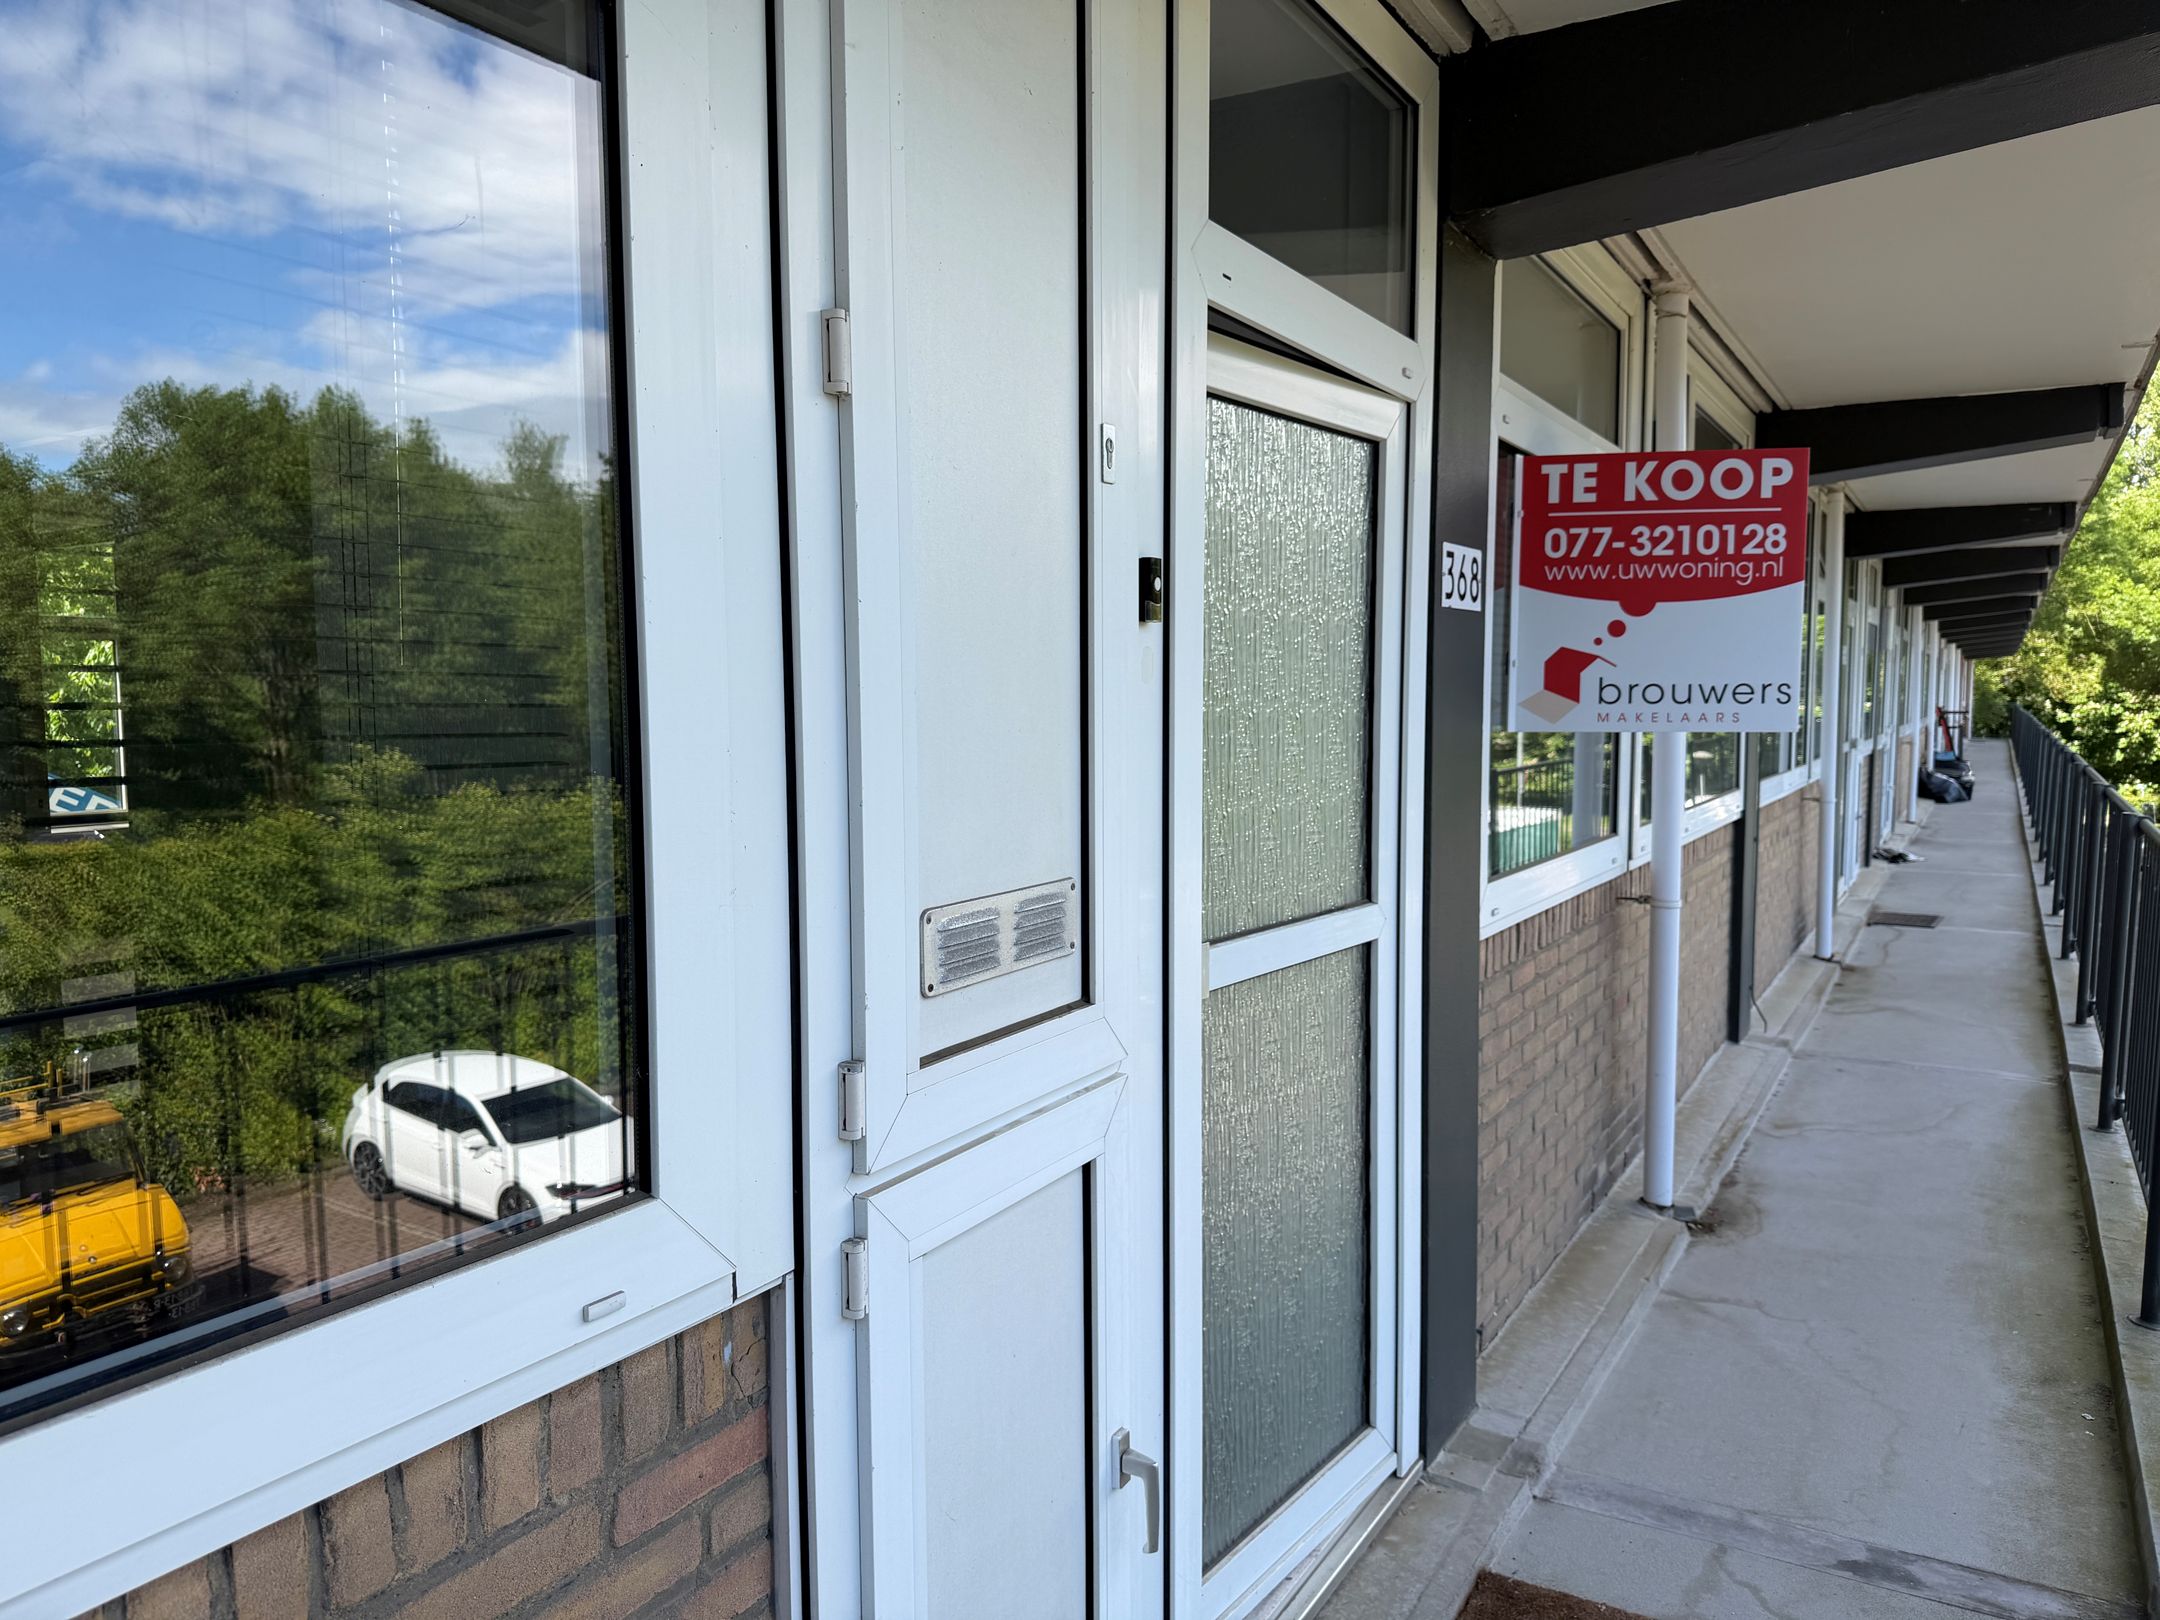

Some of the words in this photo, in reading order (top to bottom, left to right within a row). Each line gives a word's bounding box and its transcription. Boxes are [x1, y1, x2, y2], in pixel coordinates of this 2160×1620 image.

[1541, 463, 1598, 504] TE
[1624, 457, 1794, 502] KOOP
[1544, 522, 1787, 559] 077-3210128
[1444, 550, 1479, 603] 368
[1544, 556, 1784, 586] www.uwwoning.nl
[1598, 677, 1792, 705] brouwers
[1597, 711, 1741, 724] MAKELAARS
